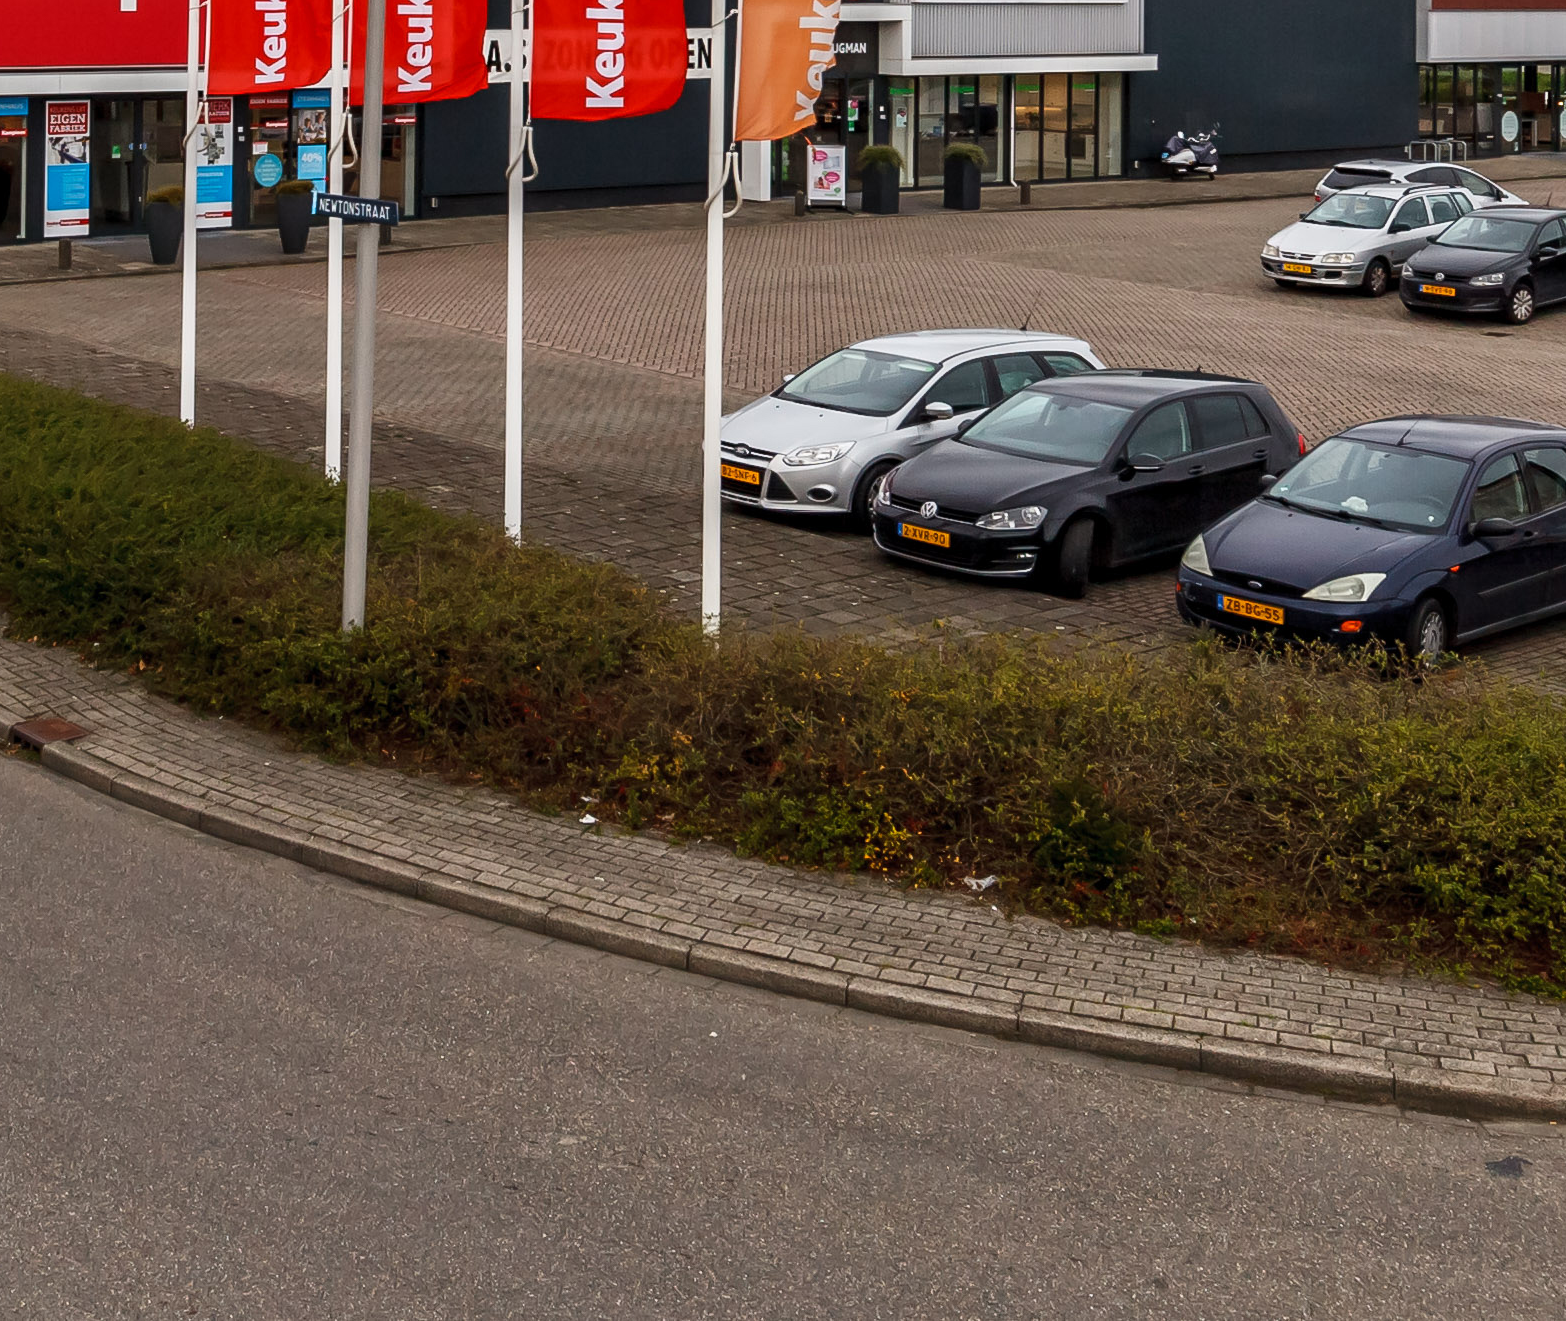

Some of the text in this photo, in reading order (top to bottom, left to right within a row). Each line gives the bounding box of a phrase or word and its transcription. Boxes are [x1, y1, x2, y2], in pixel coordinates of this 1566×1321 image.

[50, 113, 86, 125] EIGEN
[49, 124, 86, 133] FABRIEK
[318, 197, 391, 221] NEWTONSTRAAT
